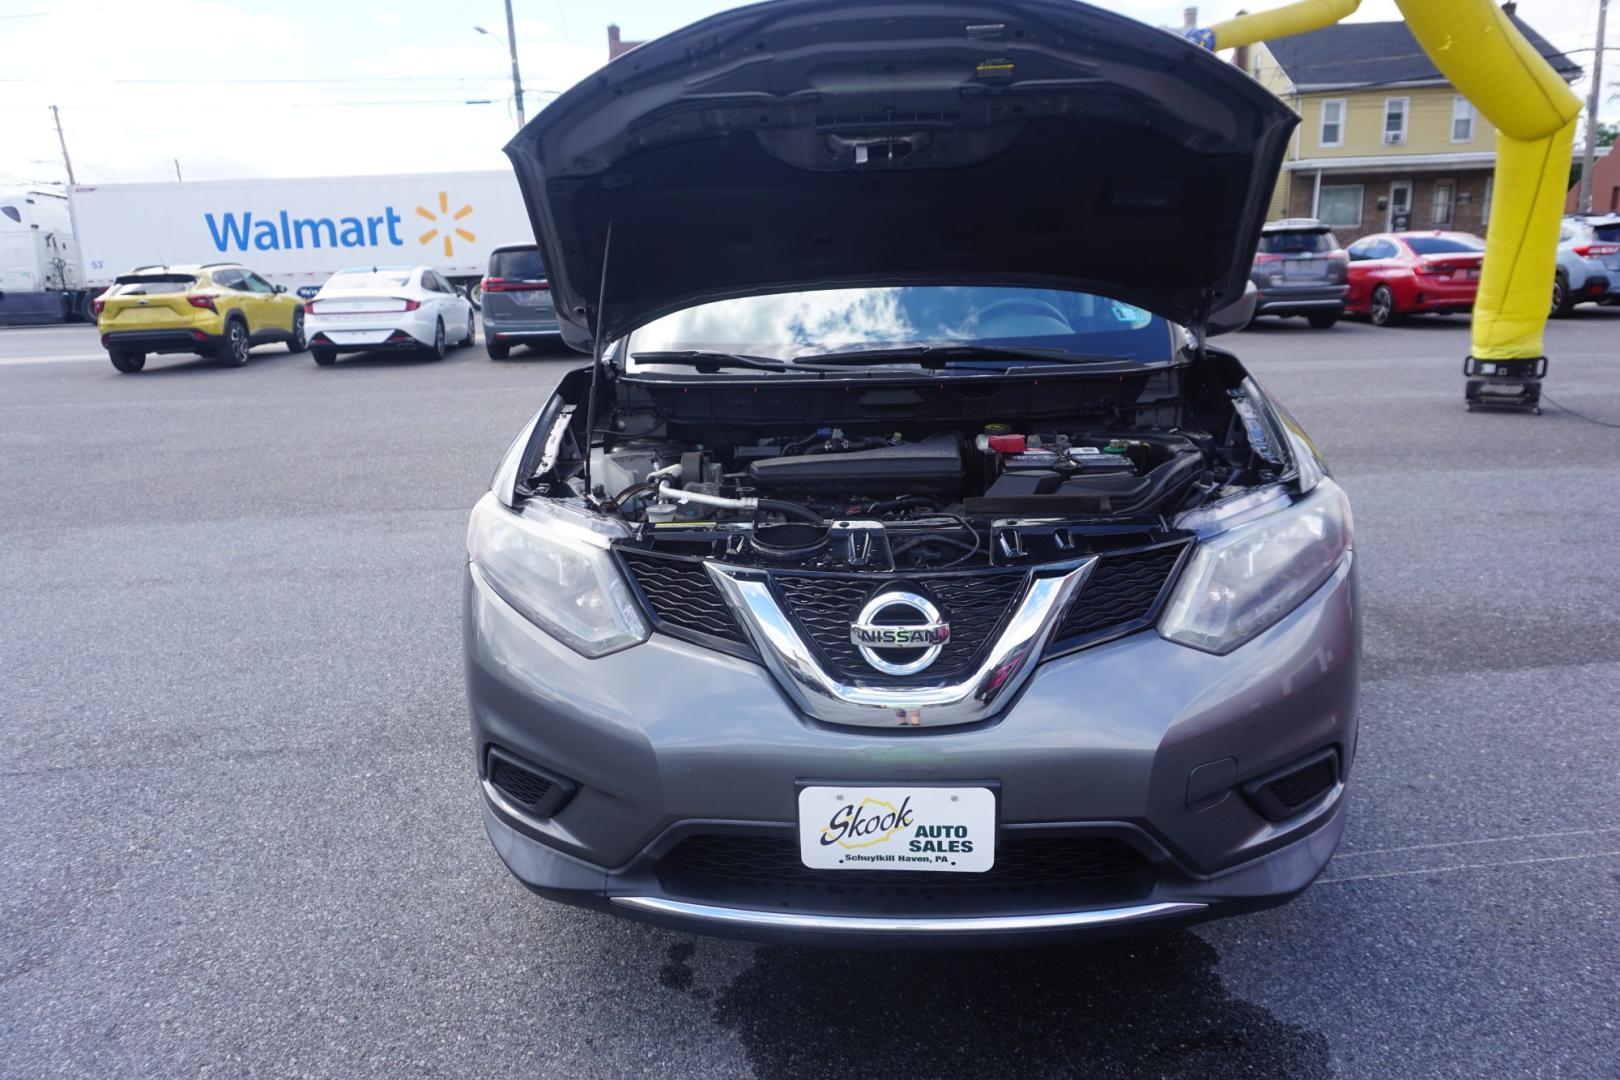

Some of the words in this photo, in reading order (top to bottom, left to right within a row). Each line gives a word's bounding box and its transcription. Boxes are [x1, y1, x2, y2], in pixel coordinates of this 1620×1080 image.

[204, 206, 404, 252] Walmart
[861, 631, 939, 643] NISSAN
[820, 795, 914, 846] Skook
[914, 825, 968, 838] AUTO
[909, 840, 973, 853] SALES
[845, 854, 895, 863] Schuylkill
[898, 855, 932, 863] Haven,
